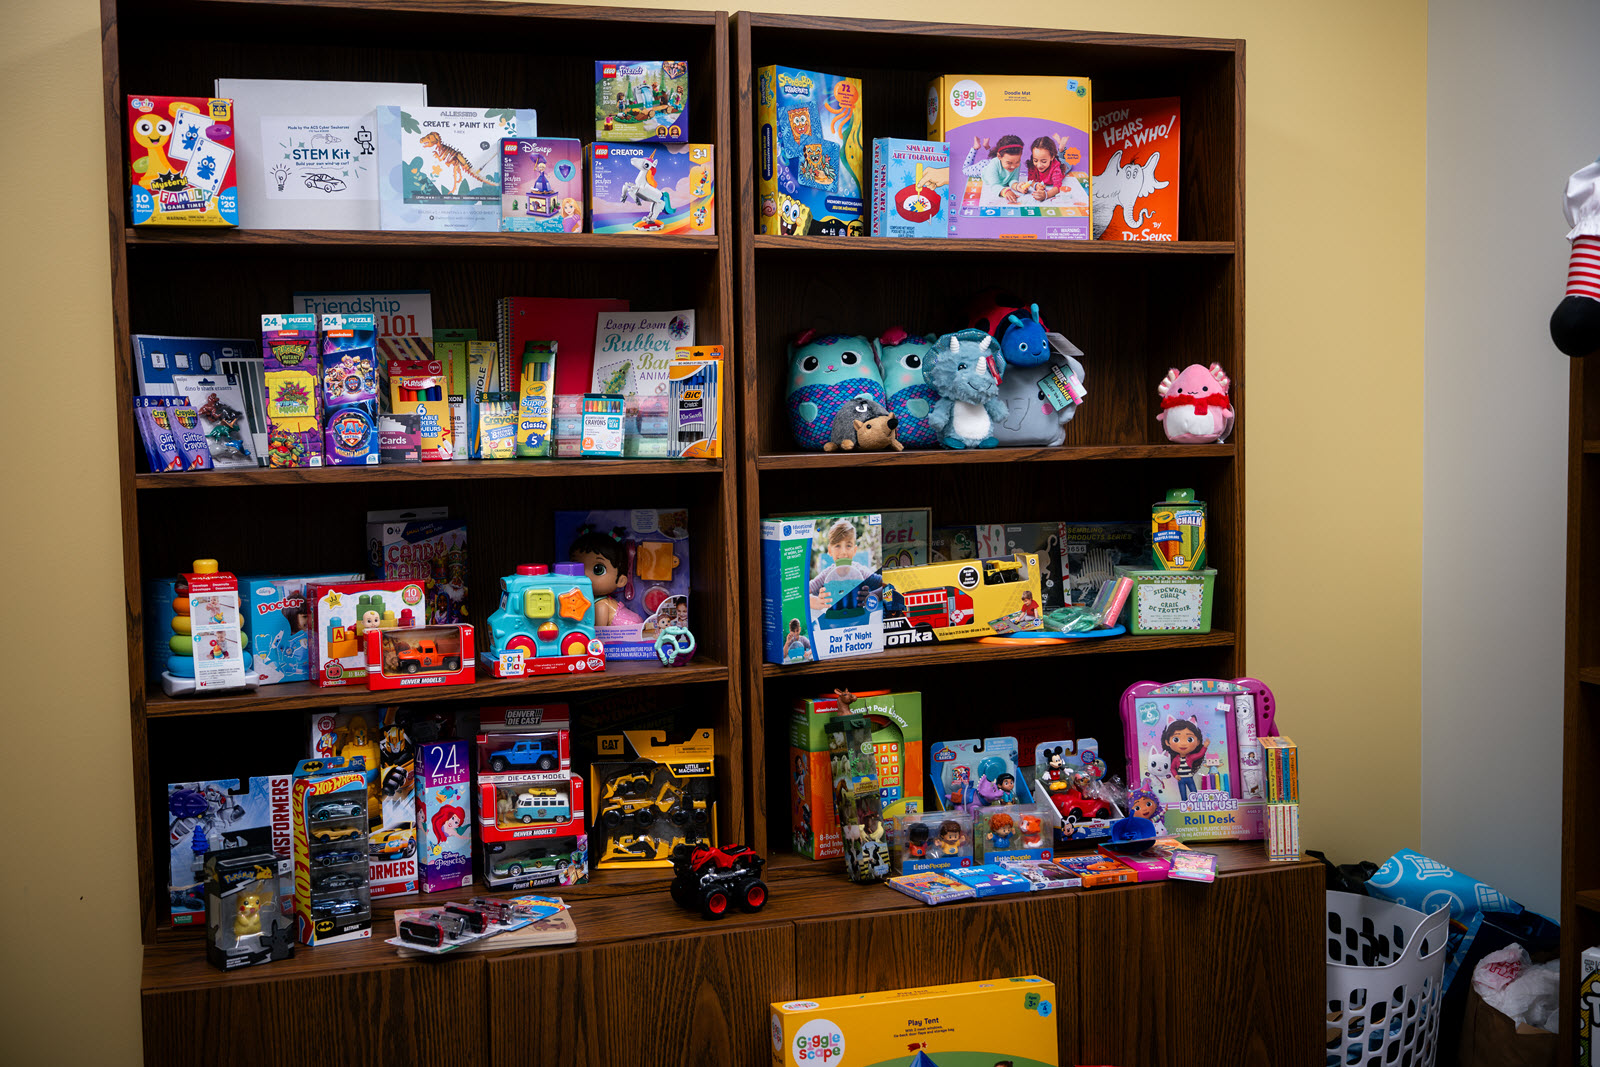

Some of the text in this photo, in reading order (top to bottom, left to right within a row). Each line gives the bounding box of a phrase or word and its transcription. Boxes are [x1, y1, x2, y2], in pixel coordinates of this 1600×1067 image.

[619, 66, 643, 77] Friends
[842, 84, 850, 92] 72
[953, 89, 983, 102] Giggle
[1103, 118, 1143, 148] HEARS
[1124, 115, 1176, 150] A WHO!
[520, 141, 552, 156] Disney
[293, 149, 350, 160] STEM Kit
[908, 153, 947, 162] TOURNOYANT
[151, 176, 188, 190] Mystery!
[136, 194, 149, 203] 10
[161, 190, 212, 204] FAMILY
[1122, 230, 1172, 241] Dr. Seuss
[304, 298, 400, 314] Friendship
[264, 318, 277, 326] 24
[324, 318, 337, 326] 24
[381, 315, 418, 337] 101
[604, 319, 666, 332] Loopy Loom
[602, 333, 671, 352] Rubber
[474, 367, 486, 404] ORIOLE
[1052, 376, 1071, 401] PLUSHIE
[144, 398, 148, 406] 8
[521, 398, 547, 408] Super
[175, 409, 196, 417] Crayola
[417, 404, 426, 415] 6
[335, 422, 368, 435] PAW
[183, 433, 203, 442] Glitter
[532, 436, 538, 445] 5
[184, 442, 207, 451] Crayons
[1177, 517, 1202, 526] CHALK
[388, 537, 446, 563] CANDY
[1174, 556, 1184, 565] 16
[387, 561, 432, 579] LAND
[1153, 587, 1186, 596] SIDEWALK
[258, 598, 303, 614] Doctor
[1158, 605, 1191, 613] TROTTOIR
[336, 631, 342, 639] A
[855, 632, 872, 641] Night
[829, 641, 872, 654] Ant Factory
[502, 655, 521, 663] Sort
[507, 663, 525, 672] Play
[874, 705, 908, 728] Pad Library
[601, 740, 619, 750] CAT
[431, 744, 460, 778] 24
[433, 776, 461, 785] PUZZLE
[1189, 793, 1228, 802] GABBY'S
[1180, 801, 1238, 811] DOLLHOUSE
[1184, 814, 1235, 825] Roll Desk
[820, 832, 840, 841] 8-Book
[820, 848, 839, 857] Activity
[435, 858, 466, 869] Princess
[224, 871, 254, 883] Pokémon
[512, 881, 530, 890] POWER
[533, 878, 556, 887] RANGERS
[797, 1033, 840, 1051] Giggle
